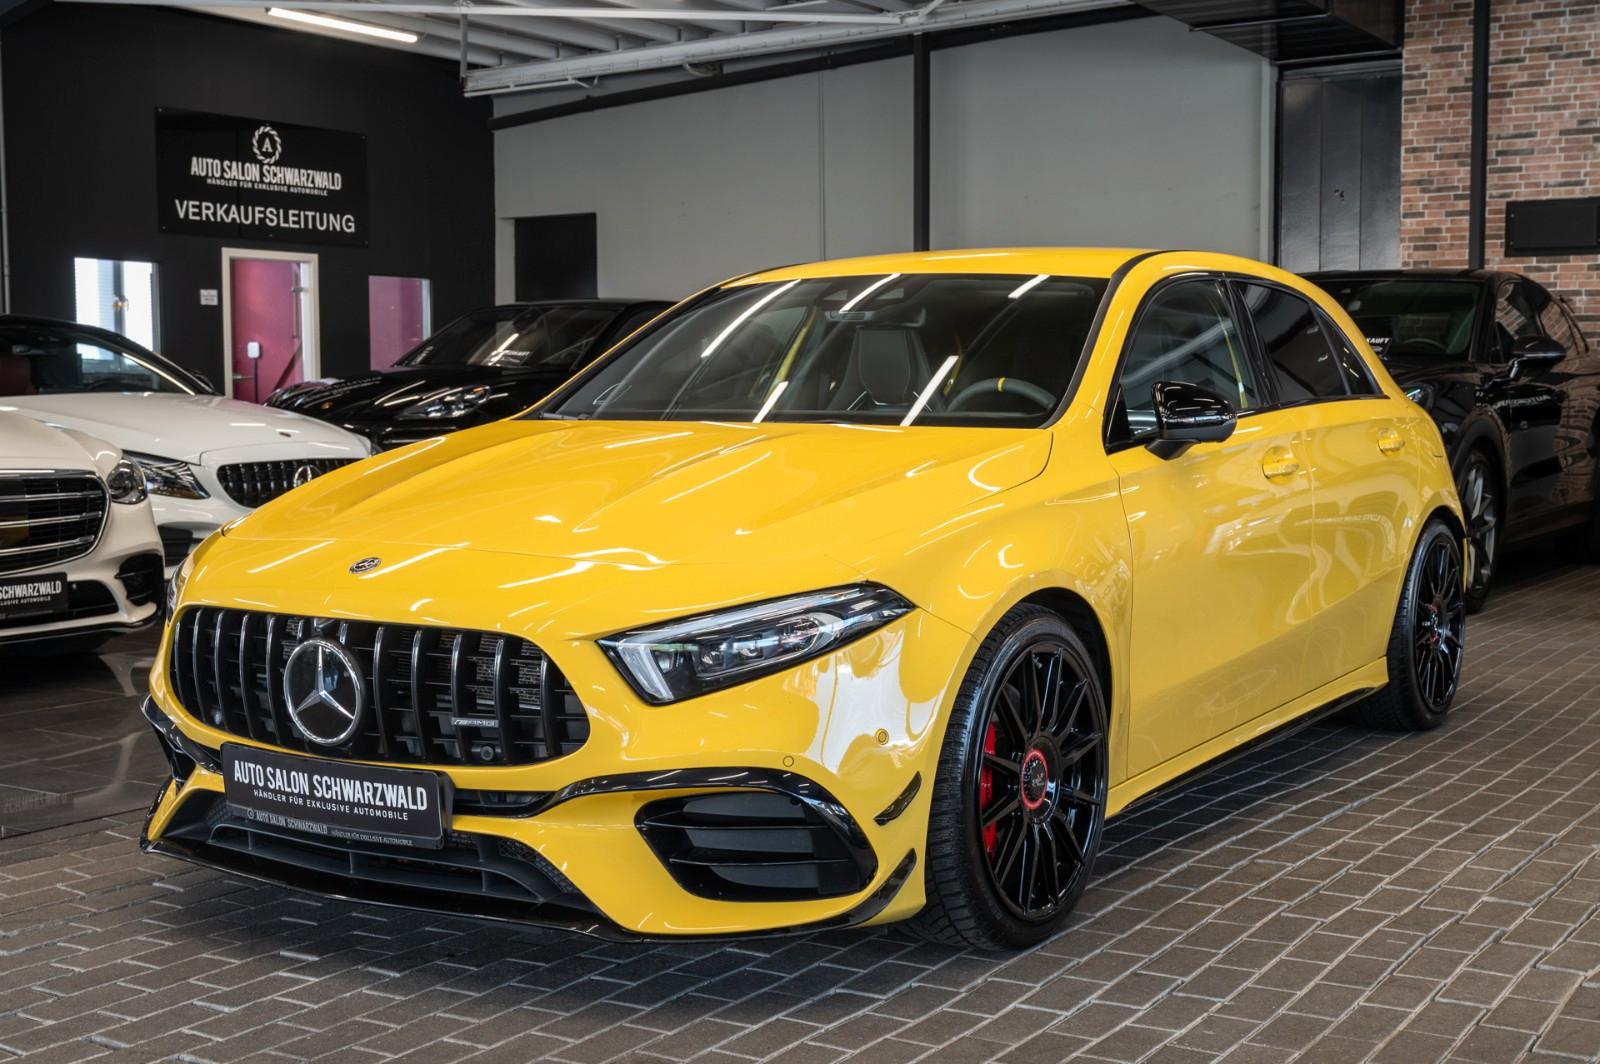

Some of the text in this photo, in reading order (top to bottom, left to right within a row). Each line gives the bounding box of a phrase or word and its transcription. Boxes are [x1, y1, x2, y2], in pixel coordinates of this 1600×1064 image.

[261, 137, 273, 152] A
[190, 156, 342, 190] AUTO SALON SCHWARZWALD
[206, 177, 328, 196] HÄNDLER FÜR EXKLUSIVE AUTOMOBILE
[175, 199, 356, 233] VERKAUFSLEITUNG
[234, 760, 428, 811] AUTO SALON SCHWARZWALD
[253, 789, 409, 821] HÄNDLER FÜR EXKLUSIVE AUTOMOBILE
[256, 810, 269, 823] AUTO
[269, 813, 286, 828] SALON
[287, 818, 328, 834] SCHWARZWALD
